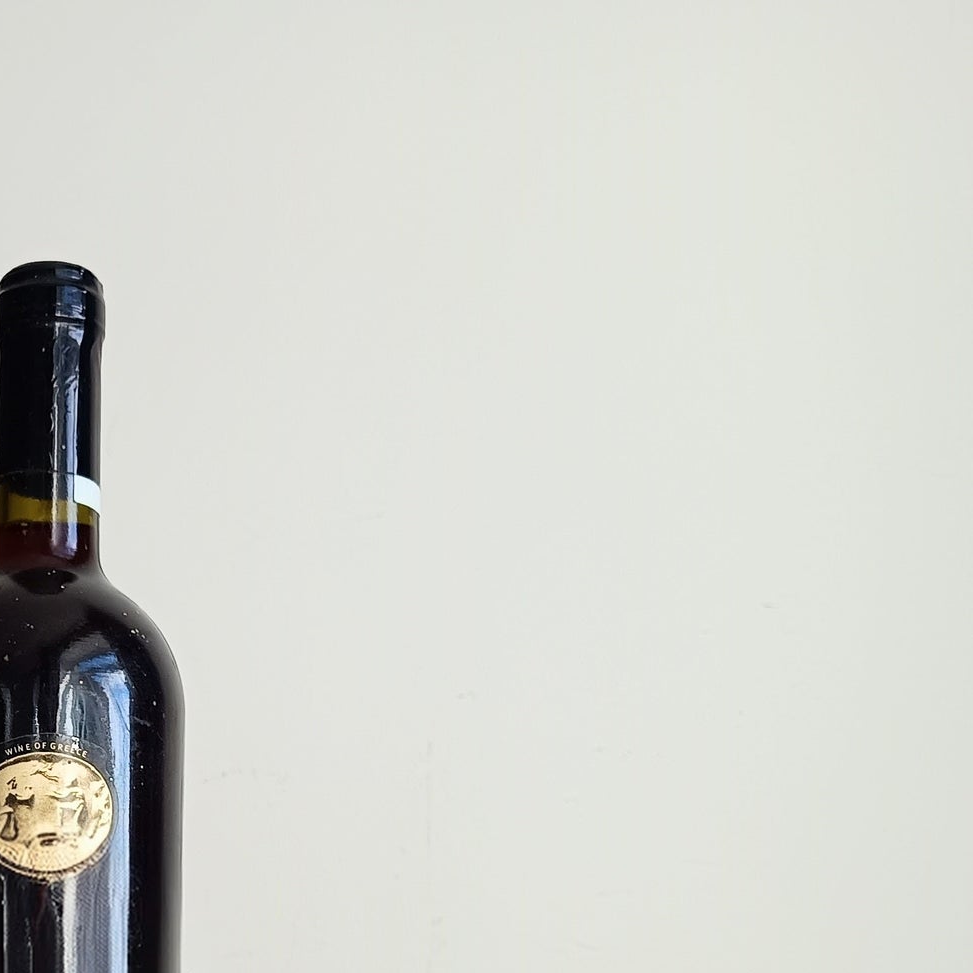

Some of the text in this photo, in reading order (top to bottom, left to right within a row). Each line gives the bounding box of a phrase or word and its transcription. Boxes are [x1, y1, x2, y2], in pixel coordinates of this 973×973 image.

[4, 741, 88, 758] WINE OF GREECE
